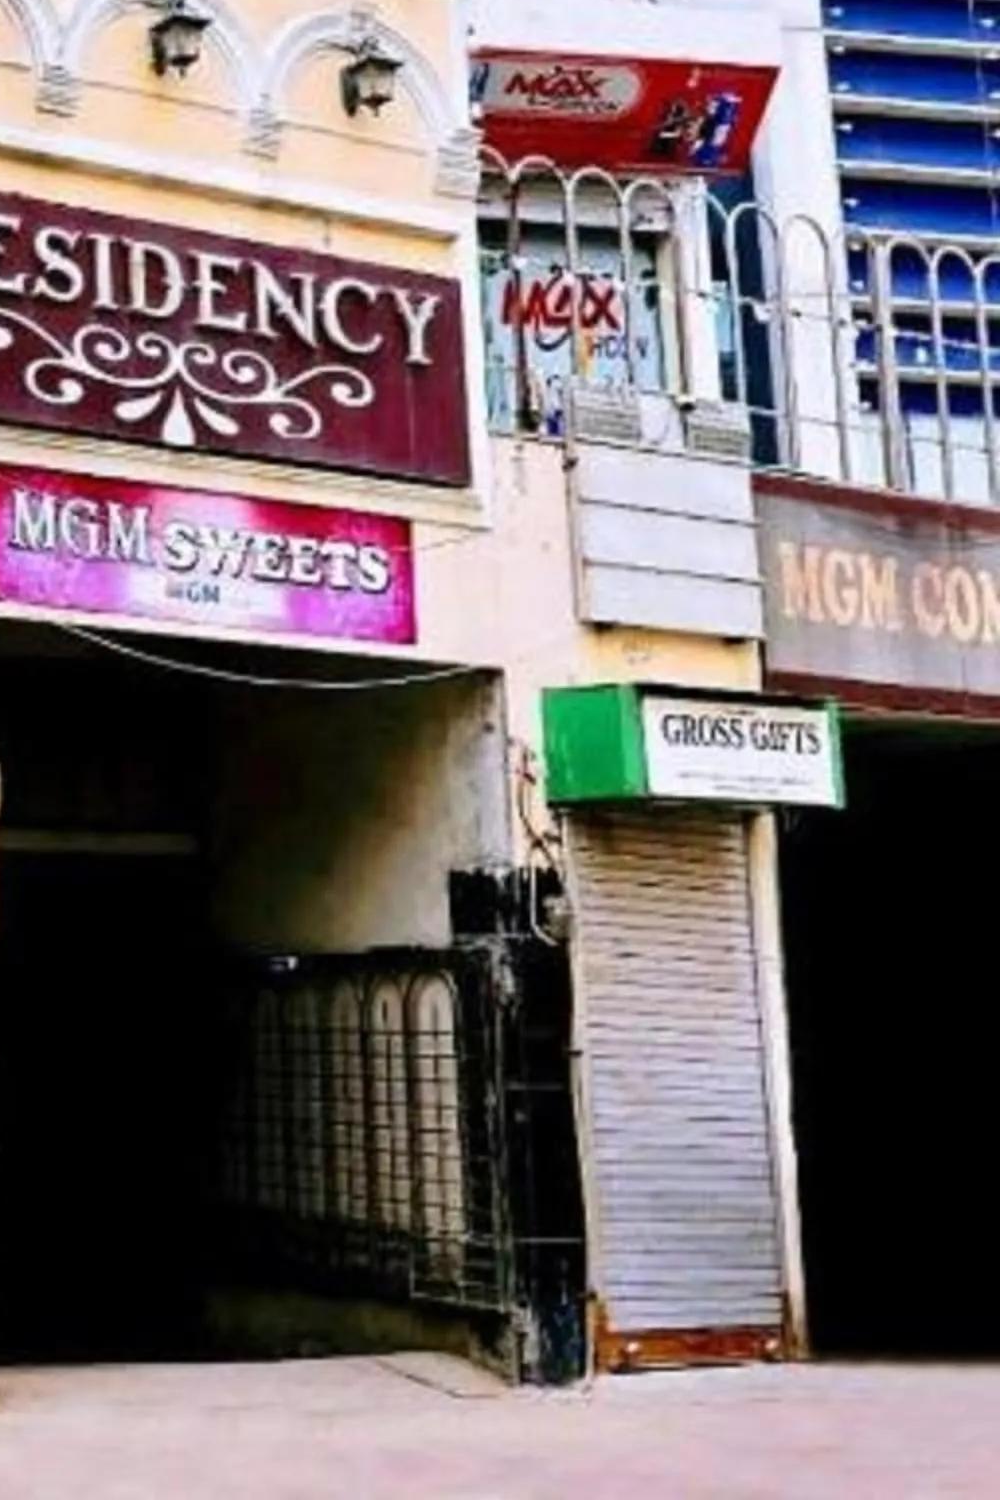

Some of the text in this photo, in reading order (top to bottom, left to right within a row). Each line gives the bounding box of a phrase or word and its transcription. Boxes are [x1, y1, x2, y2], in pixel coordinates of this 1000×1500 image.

[8, 487, 393, 594] MGM SWEETS
[779, 541, 904, 631] MGM
[661, 713, 822, 755] GROSS GIFTS
